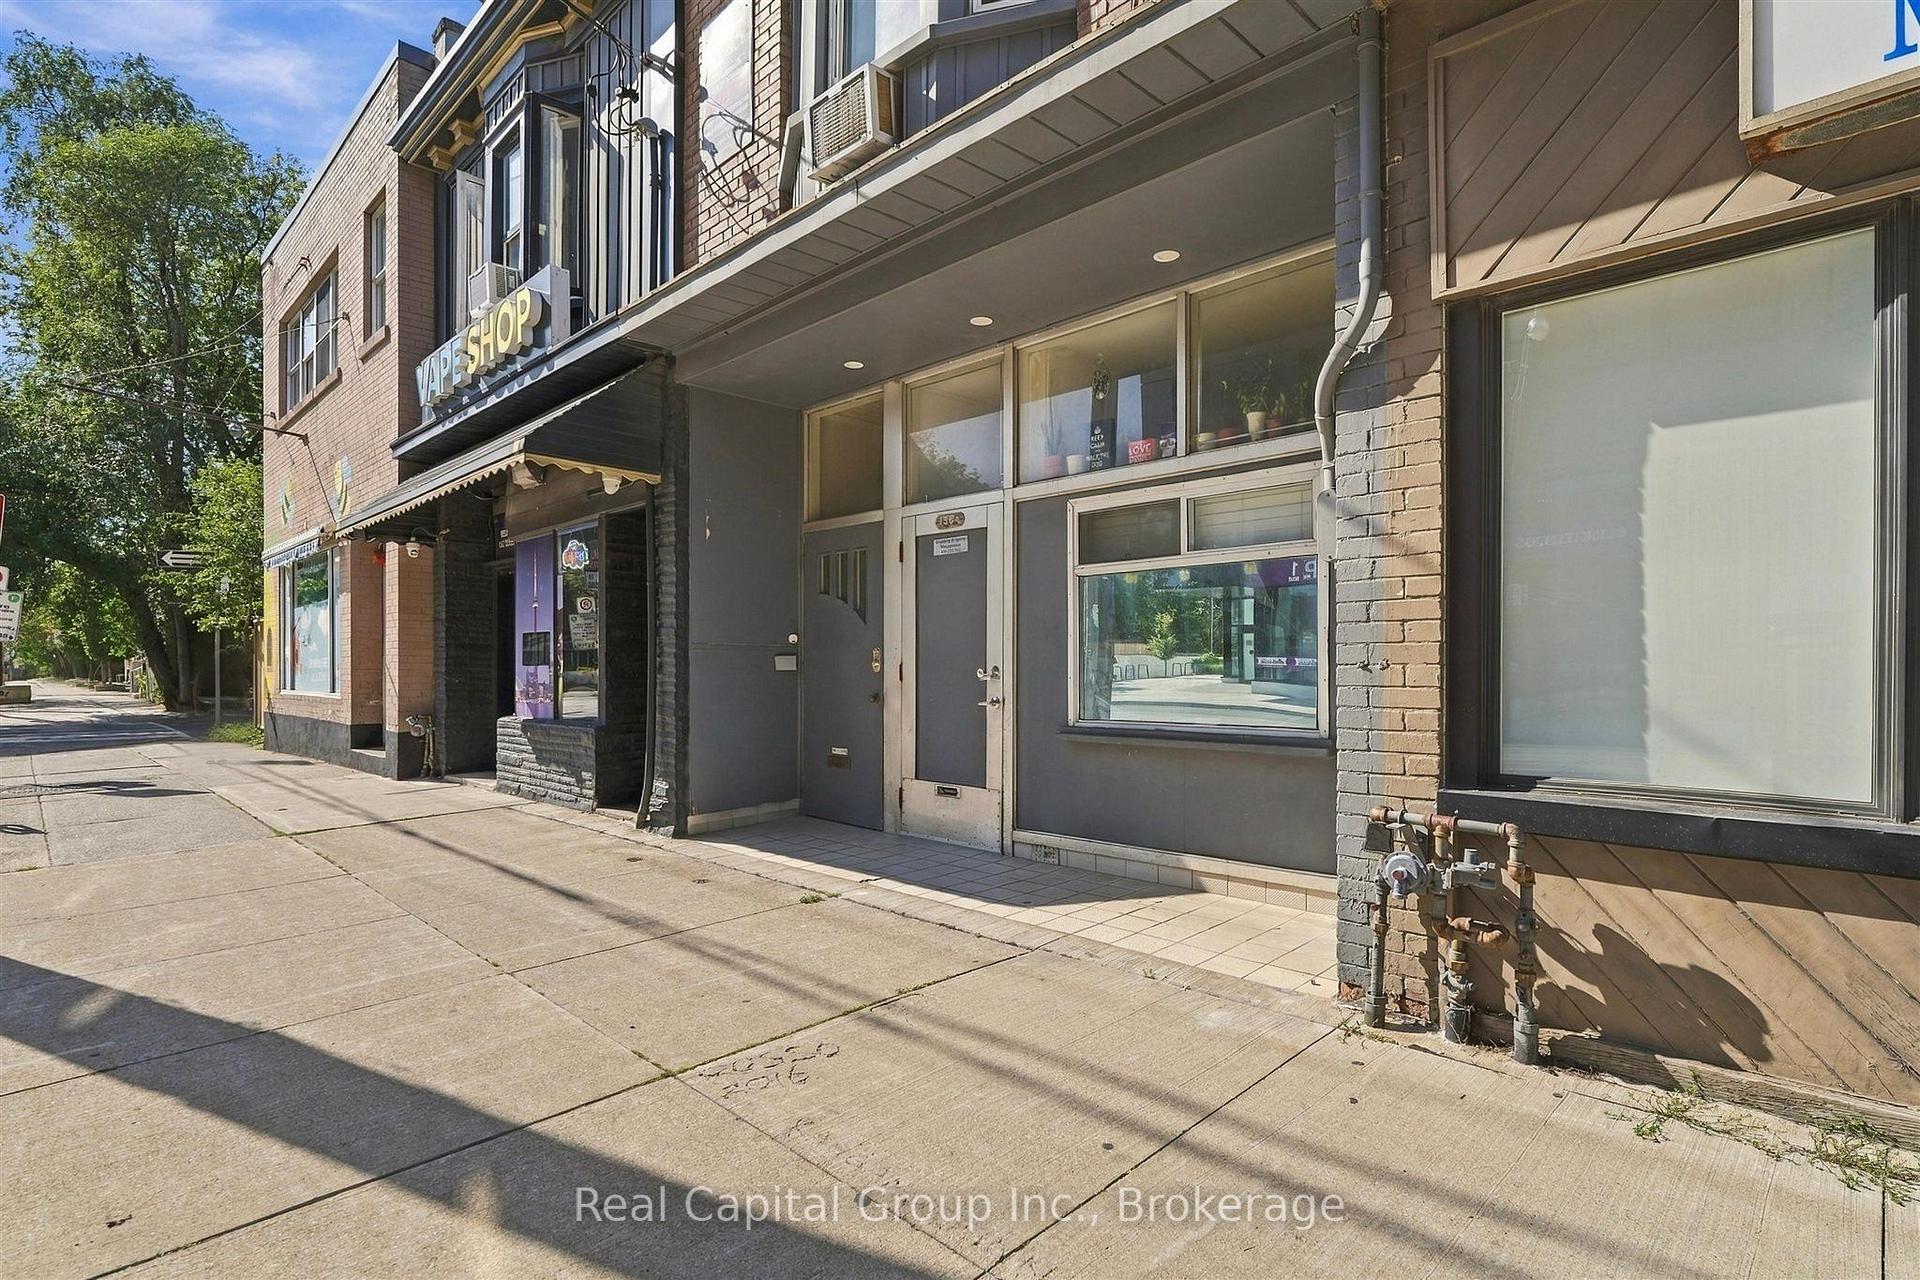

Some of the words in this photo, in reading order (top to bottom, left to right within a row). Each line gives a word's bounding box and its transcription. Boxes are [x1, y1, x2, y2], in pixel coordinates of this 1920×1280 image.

[415, 337, 468, 407] VAPE
[466, 286, 541, 375] SHOP
[1128, 443, 1151, 455] LOVE
